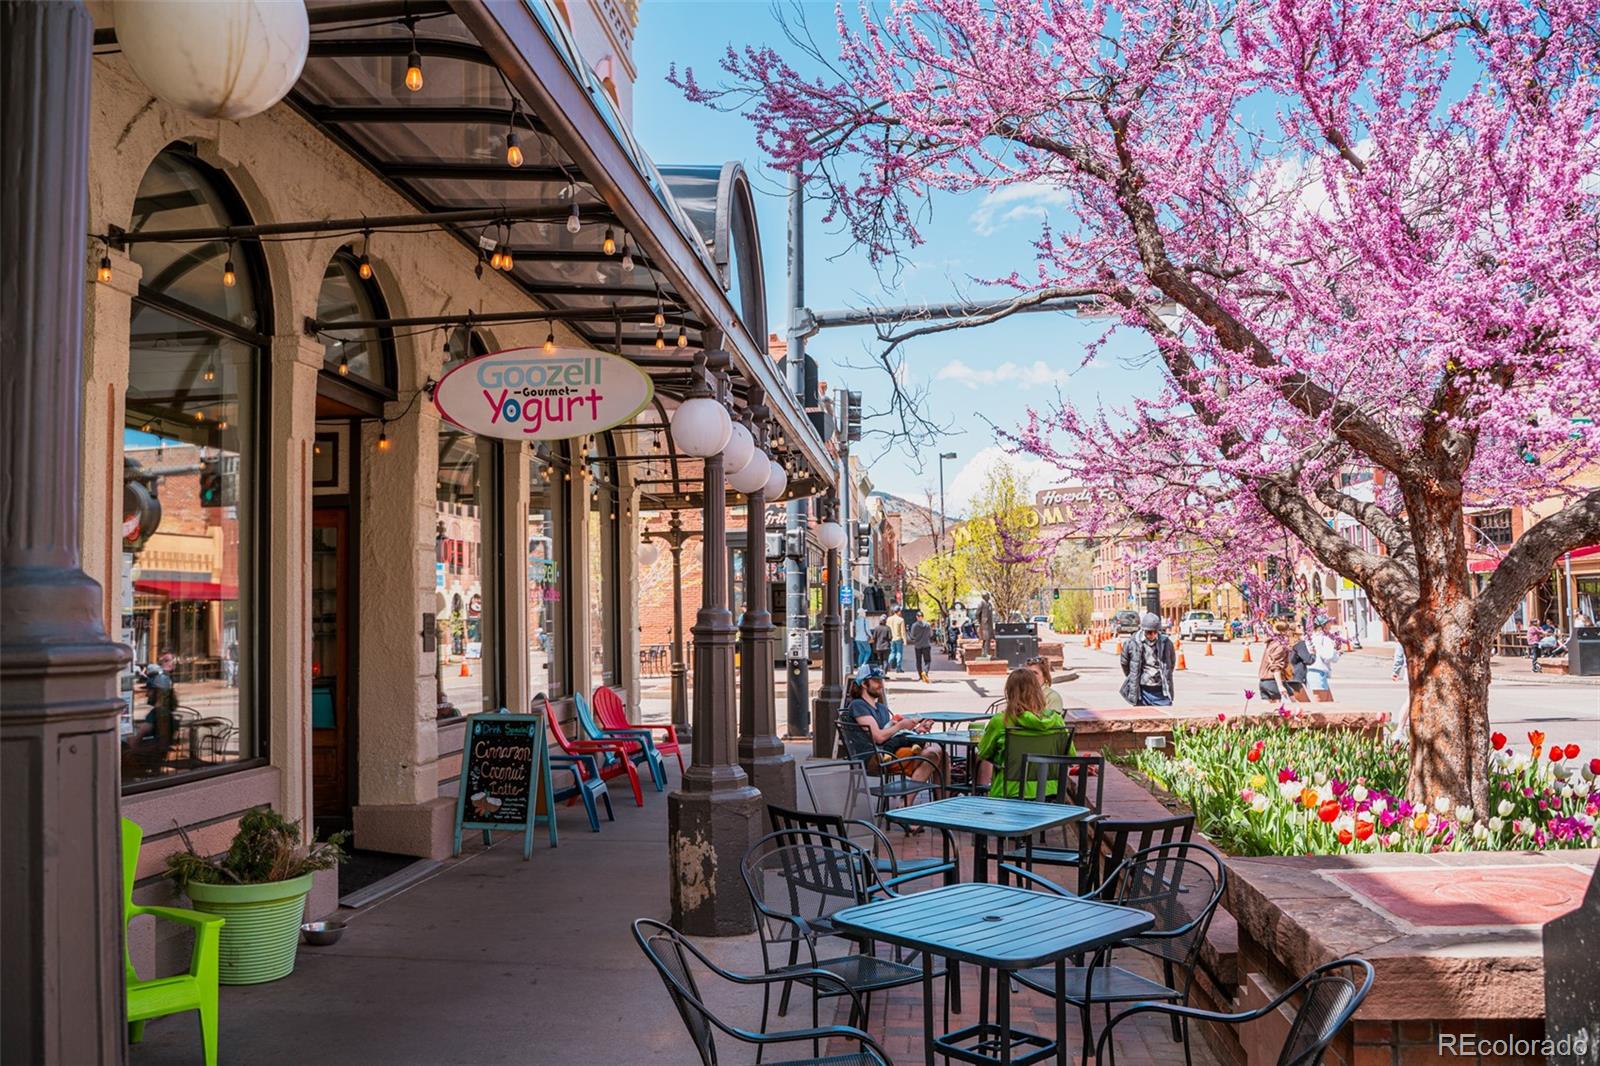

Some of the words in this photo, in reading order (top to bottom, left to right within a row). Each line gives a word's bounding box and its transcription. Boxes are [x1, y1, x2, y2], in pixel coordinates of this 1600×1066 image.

[476, 357, 602, 388] Goozell
[522, 387, 570, 397] Gourmet
[483, 388, 603, 433] Yogurt
[1042, 490, 1092, 505] Howdy
[475, 740, 531, 761] Cinnamon
[481, 761, 525, 780] Coconut
[489, 781, 524, 796] Latte
